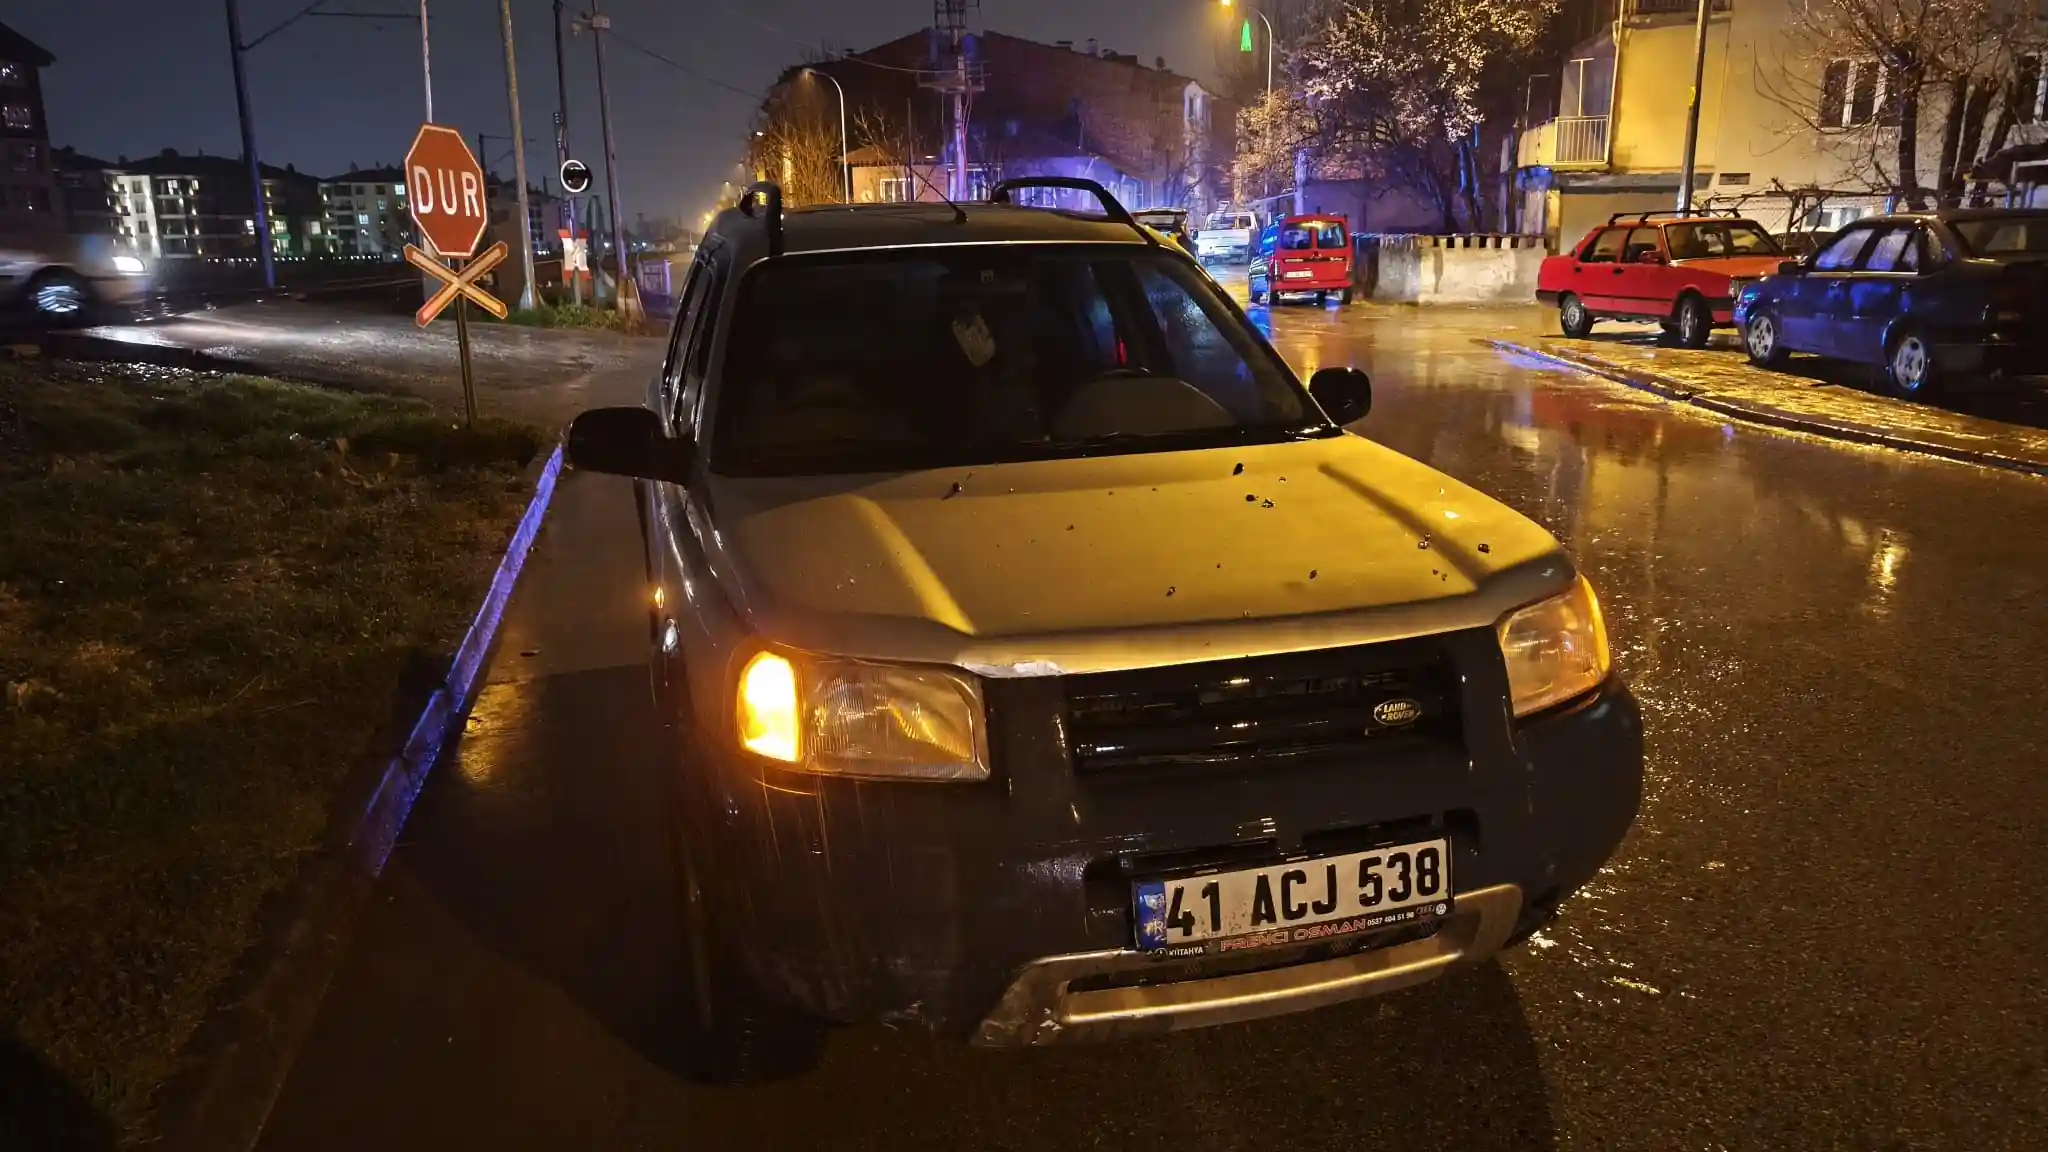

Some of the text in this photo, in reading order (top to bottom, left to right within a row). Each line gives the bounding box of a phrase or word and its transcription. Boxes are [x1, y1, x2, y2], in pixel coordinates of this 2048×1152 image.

[413, 165, 480, 217] DUR
[1383, 702, 1407, 713] LAND
[1386, 710, 1415, 721] ROVER
[1167, 847, 1440, 937] 41 ACJ 538
[1294, 918, 1366, 940] OSMAN
